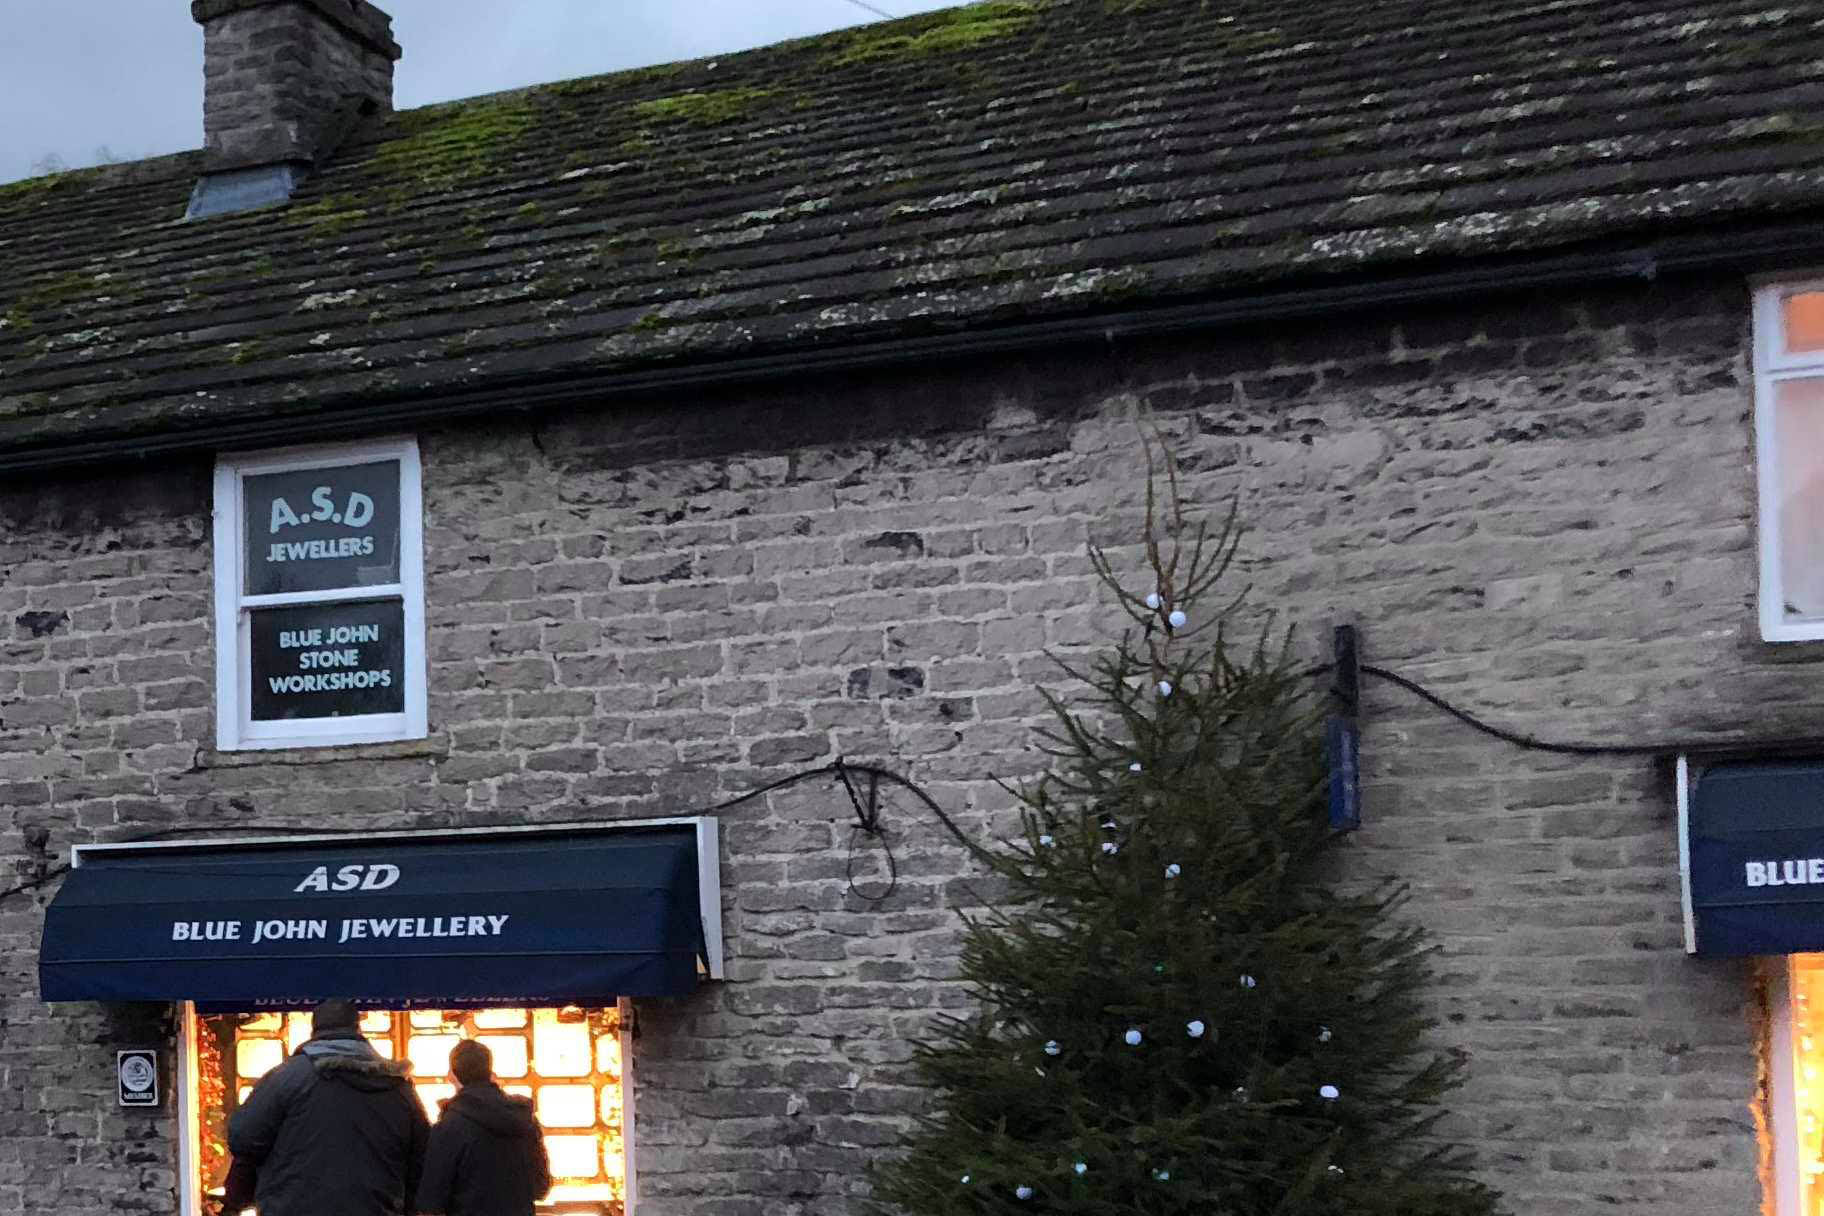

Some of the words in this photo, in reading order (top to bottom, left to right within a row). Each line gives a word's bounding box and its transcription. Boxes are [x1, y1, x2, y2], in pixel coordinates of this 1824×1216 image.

[269, 486, 375, 534] A.S.D
[266, 536, 374, 563] JEWELLERS
[279, 628, 322, 649] BLUE
[326, 624, 379, 646] JOHN
[299, 649, 359, 670] STONE
[268, 669, 392, 694] WORKSHOPS
[293, 863, 401, 893] ASD
[1745, 858, 1824, 887] BLUE
[172, 920, 242, 941] BLUE
[251, 919, 328, 944] JOHN
[338, 914, 509, 944] JEWELLERY
